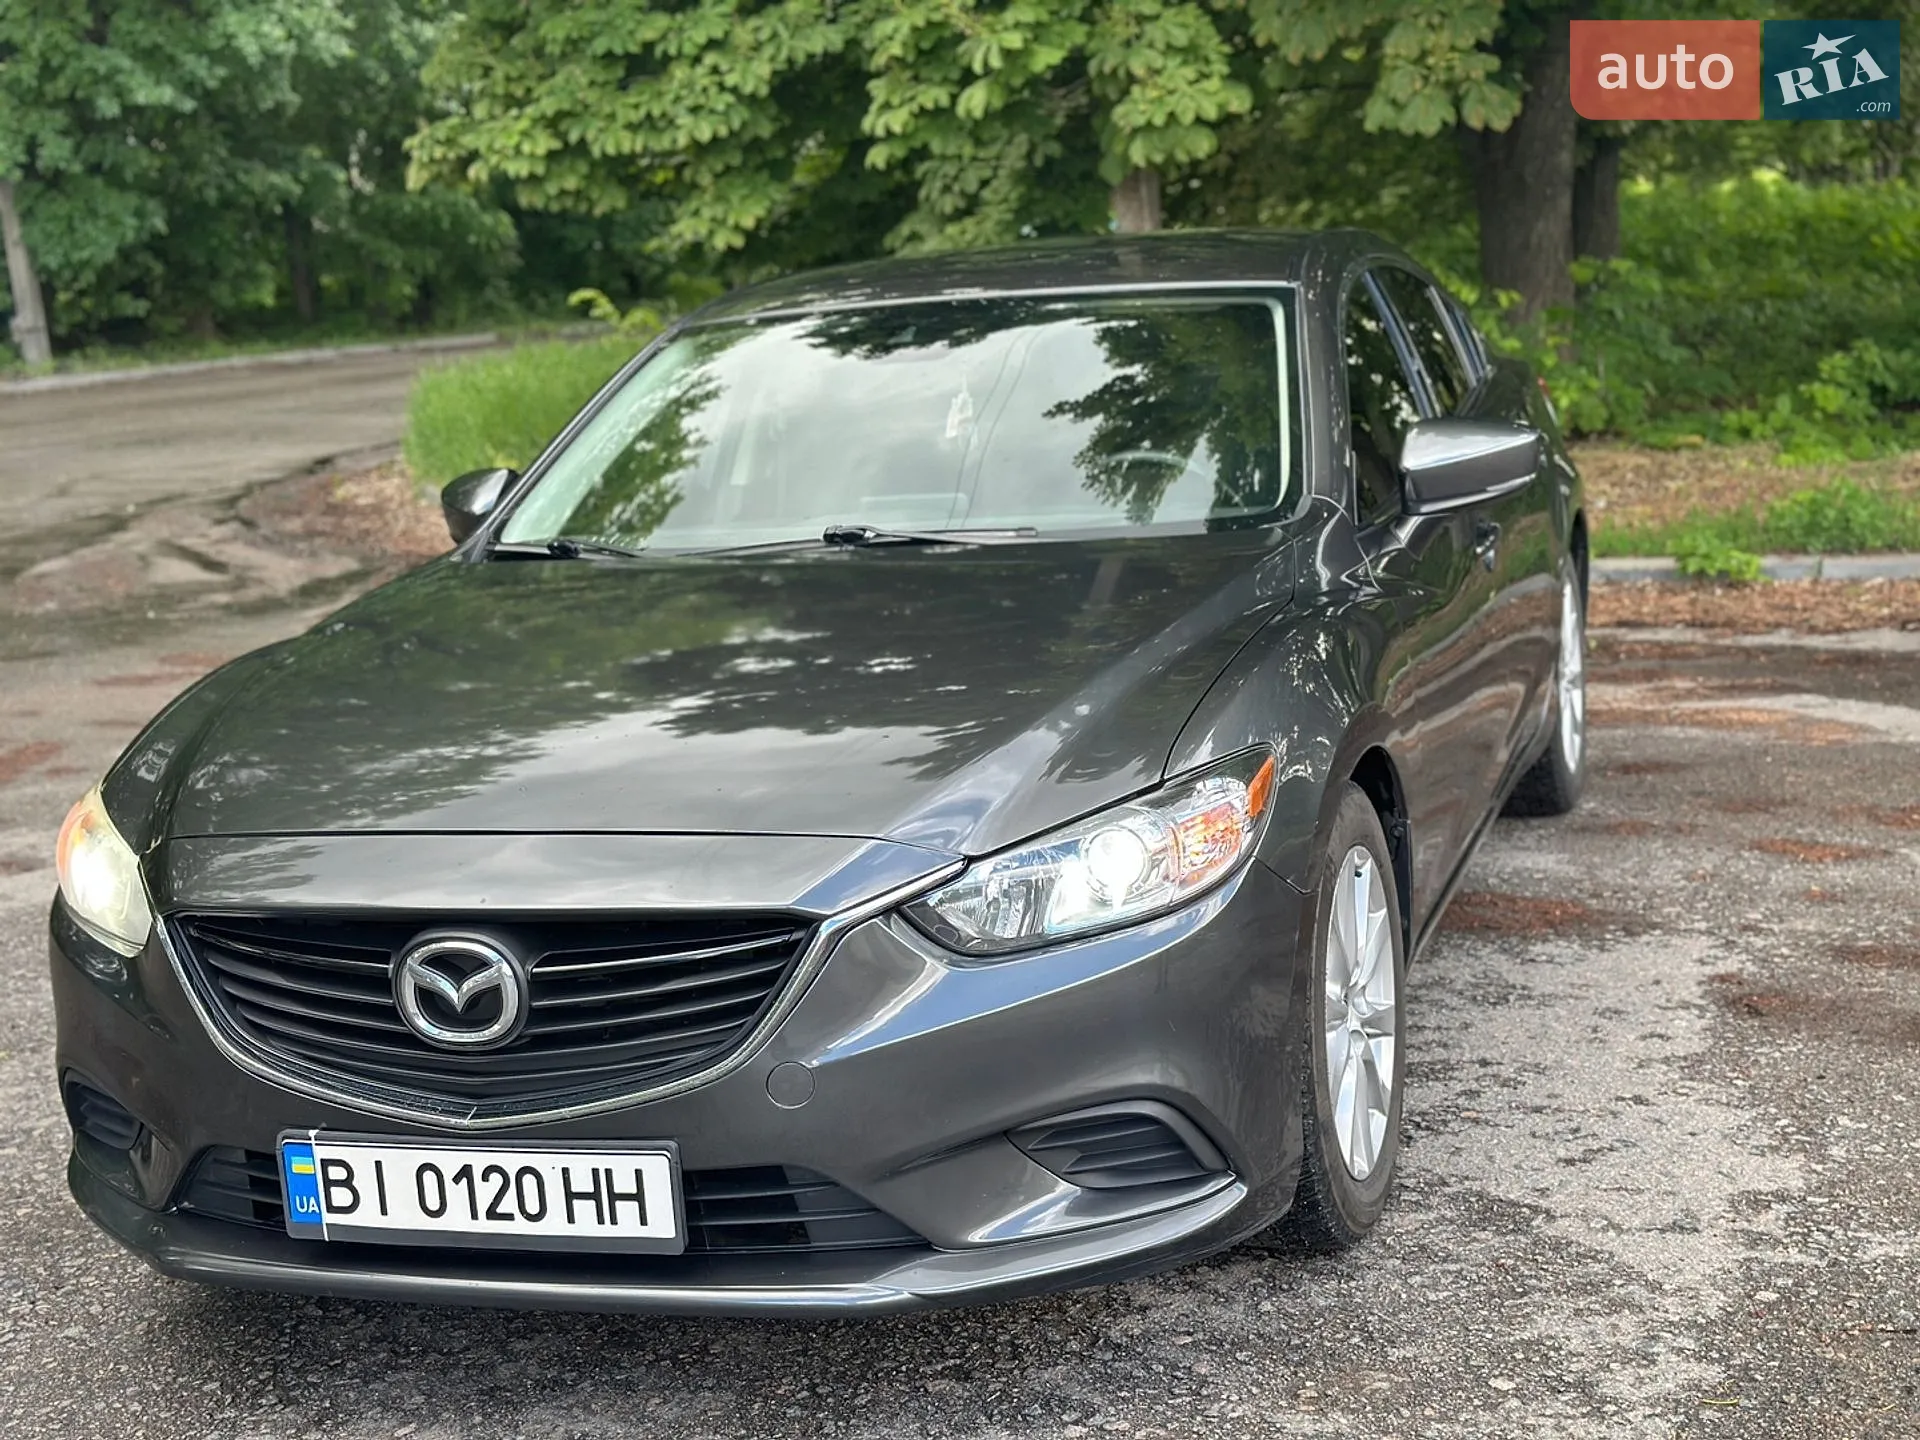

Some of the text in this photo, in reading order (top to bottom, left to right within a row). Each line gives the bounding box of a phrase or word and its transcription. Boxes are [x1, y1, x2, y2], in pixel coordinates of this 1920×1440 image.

[295, 1195, 319, 1215] UA
[320, 1158, 649, 1226] BI 0120 HH
